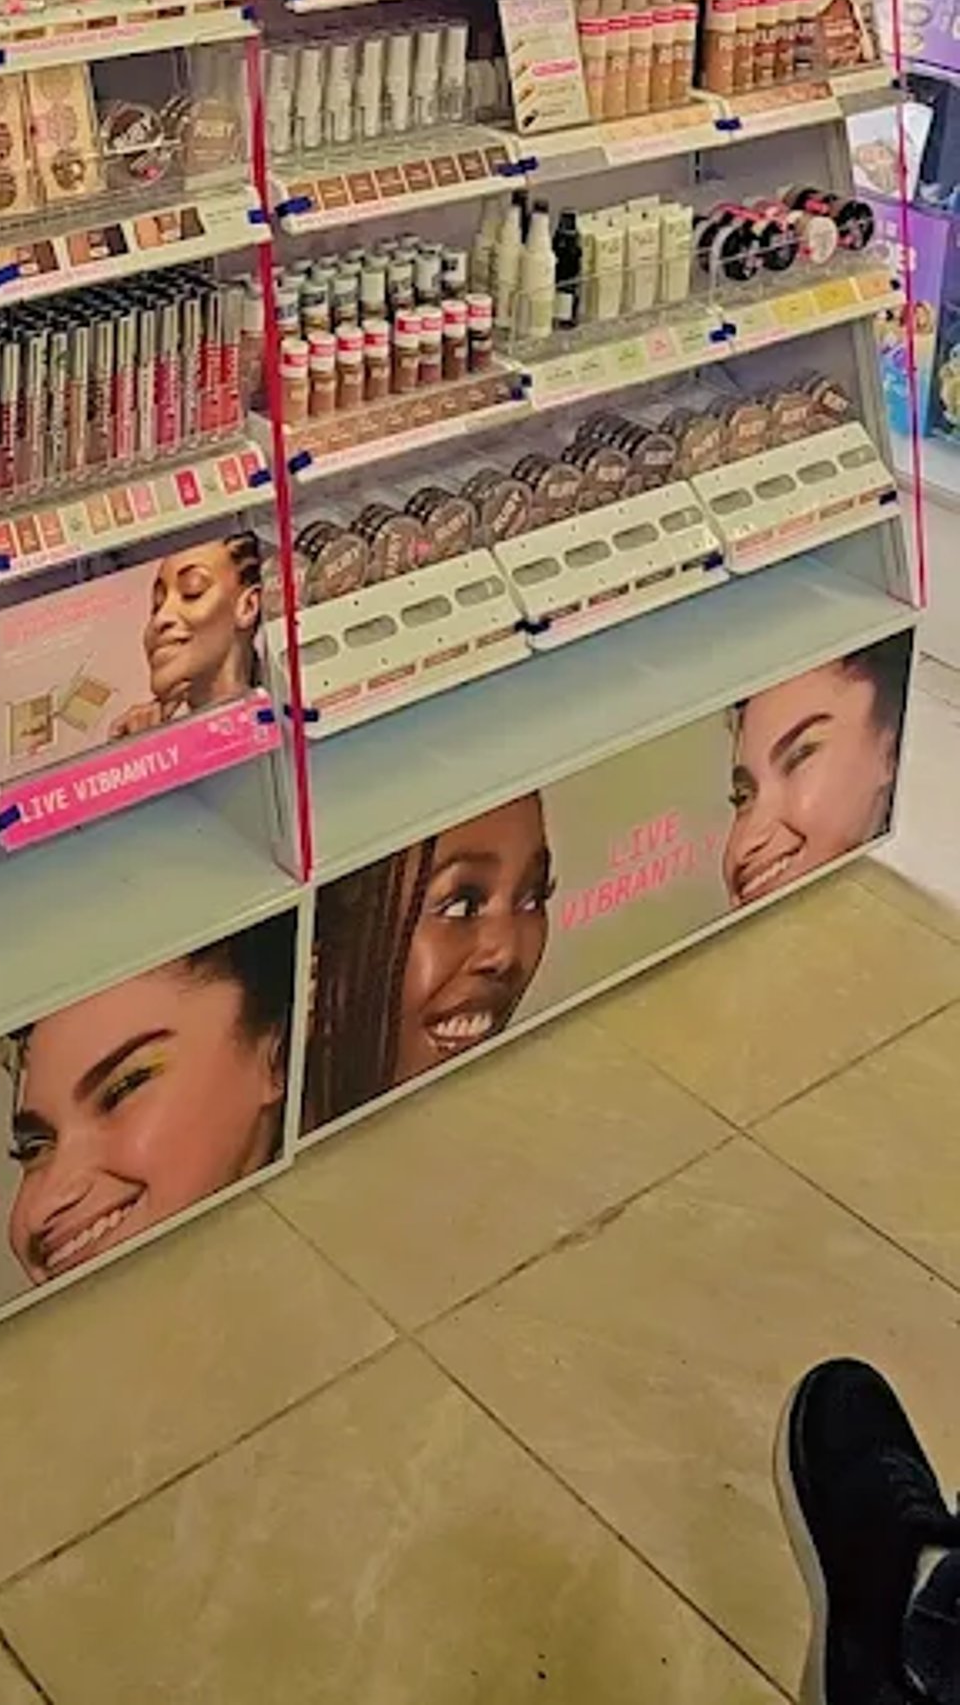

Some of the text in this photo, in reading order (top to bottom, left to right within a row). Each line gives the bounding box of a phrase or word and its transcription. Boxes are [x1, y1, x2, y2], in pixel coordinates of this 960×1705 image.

[194, 119, 234, 138] RUBY
[19, 744, 181, 826] LIVE VIBRANTLY
[609, 810, 680, 869] LIVE
[561, 832, 719, 930] VIBRANTLY
